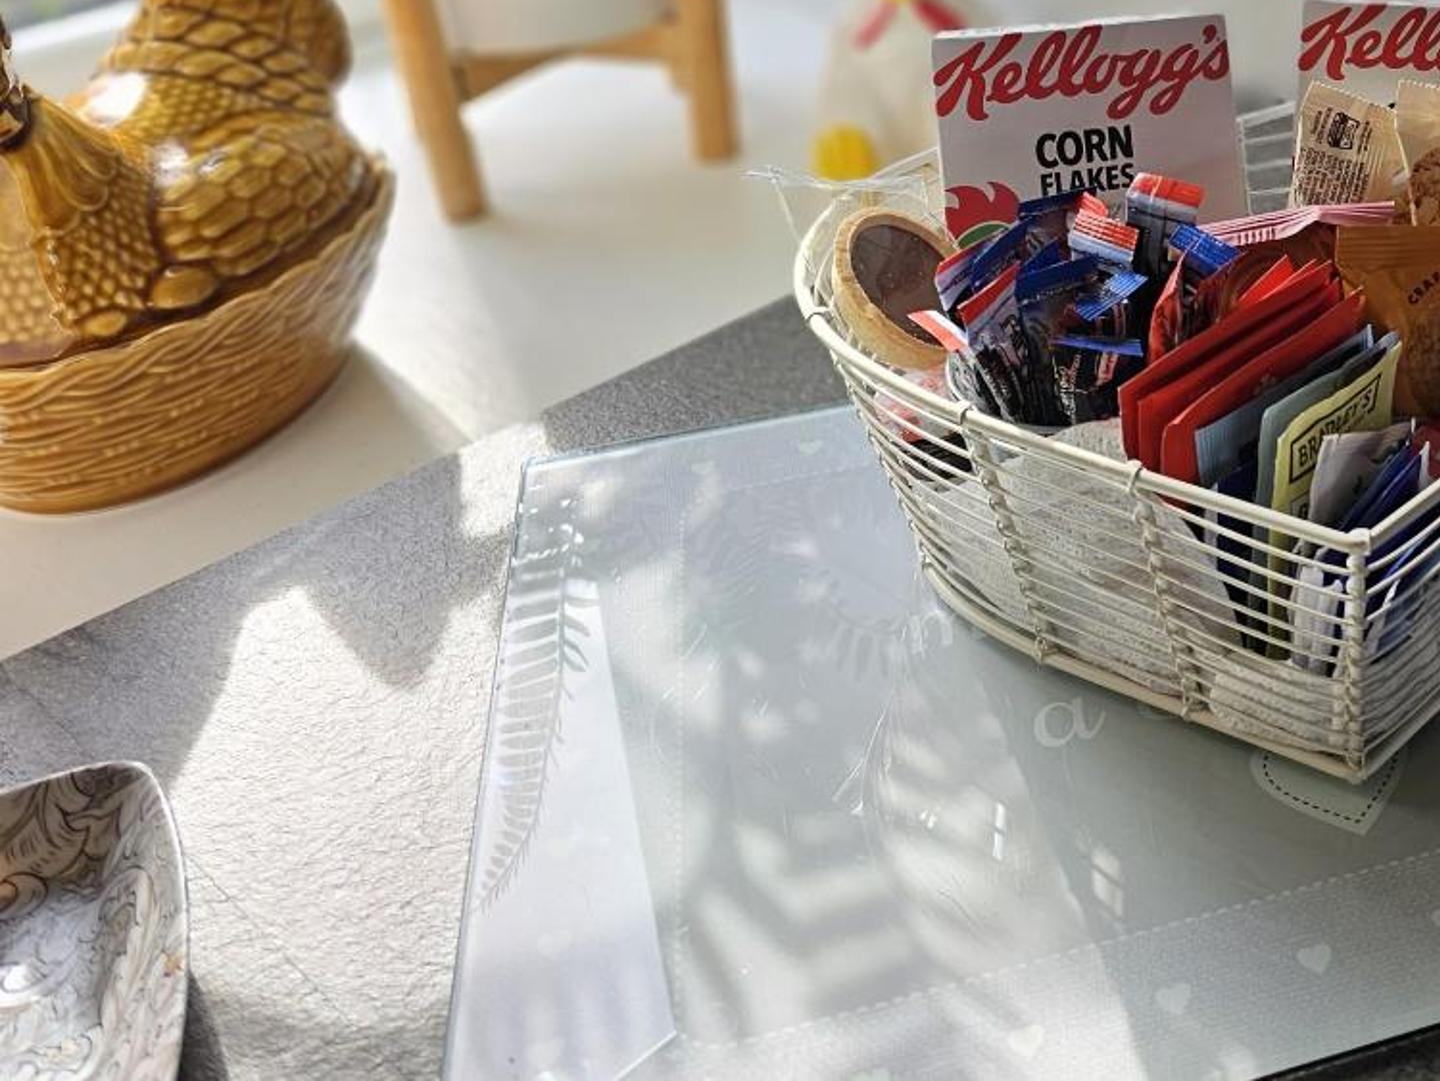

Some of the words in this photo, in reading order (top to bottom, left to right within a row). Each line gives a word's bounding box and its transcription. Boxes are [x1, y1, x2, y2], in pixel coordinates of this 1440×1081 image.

[933, 24, 1230, 120] Kellogg's
[1036, 124, 1134, 169] CORN
[1041, 163, 1134, 197] FLAKES
